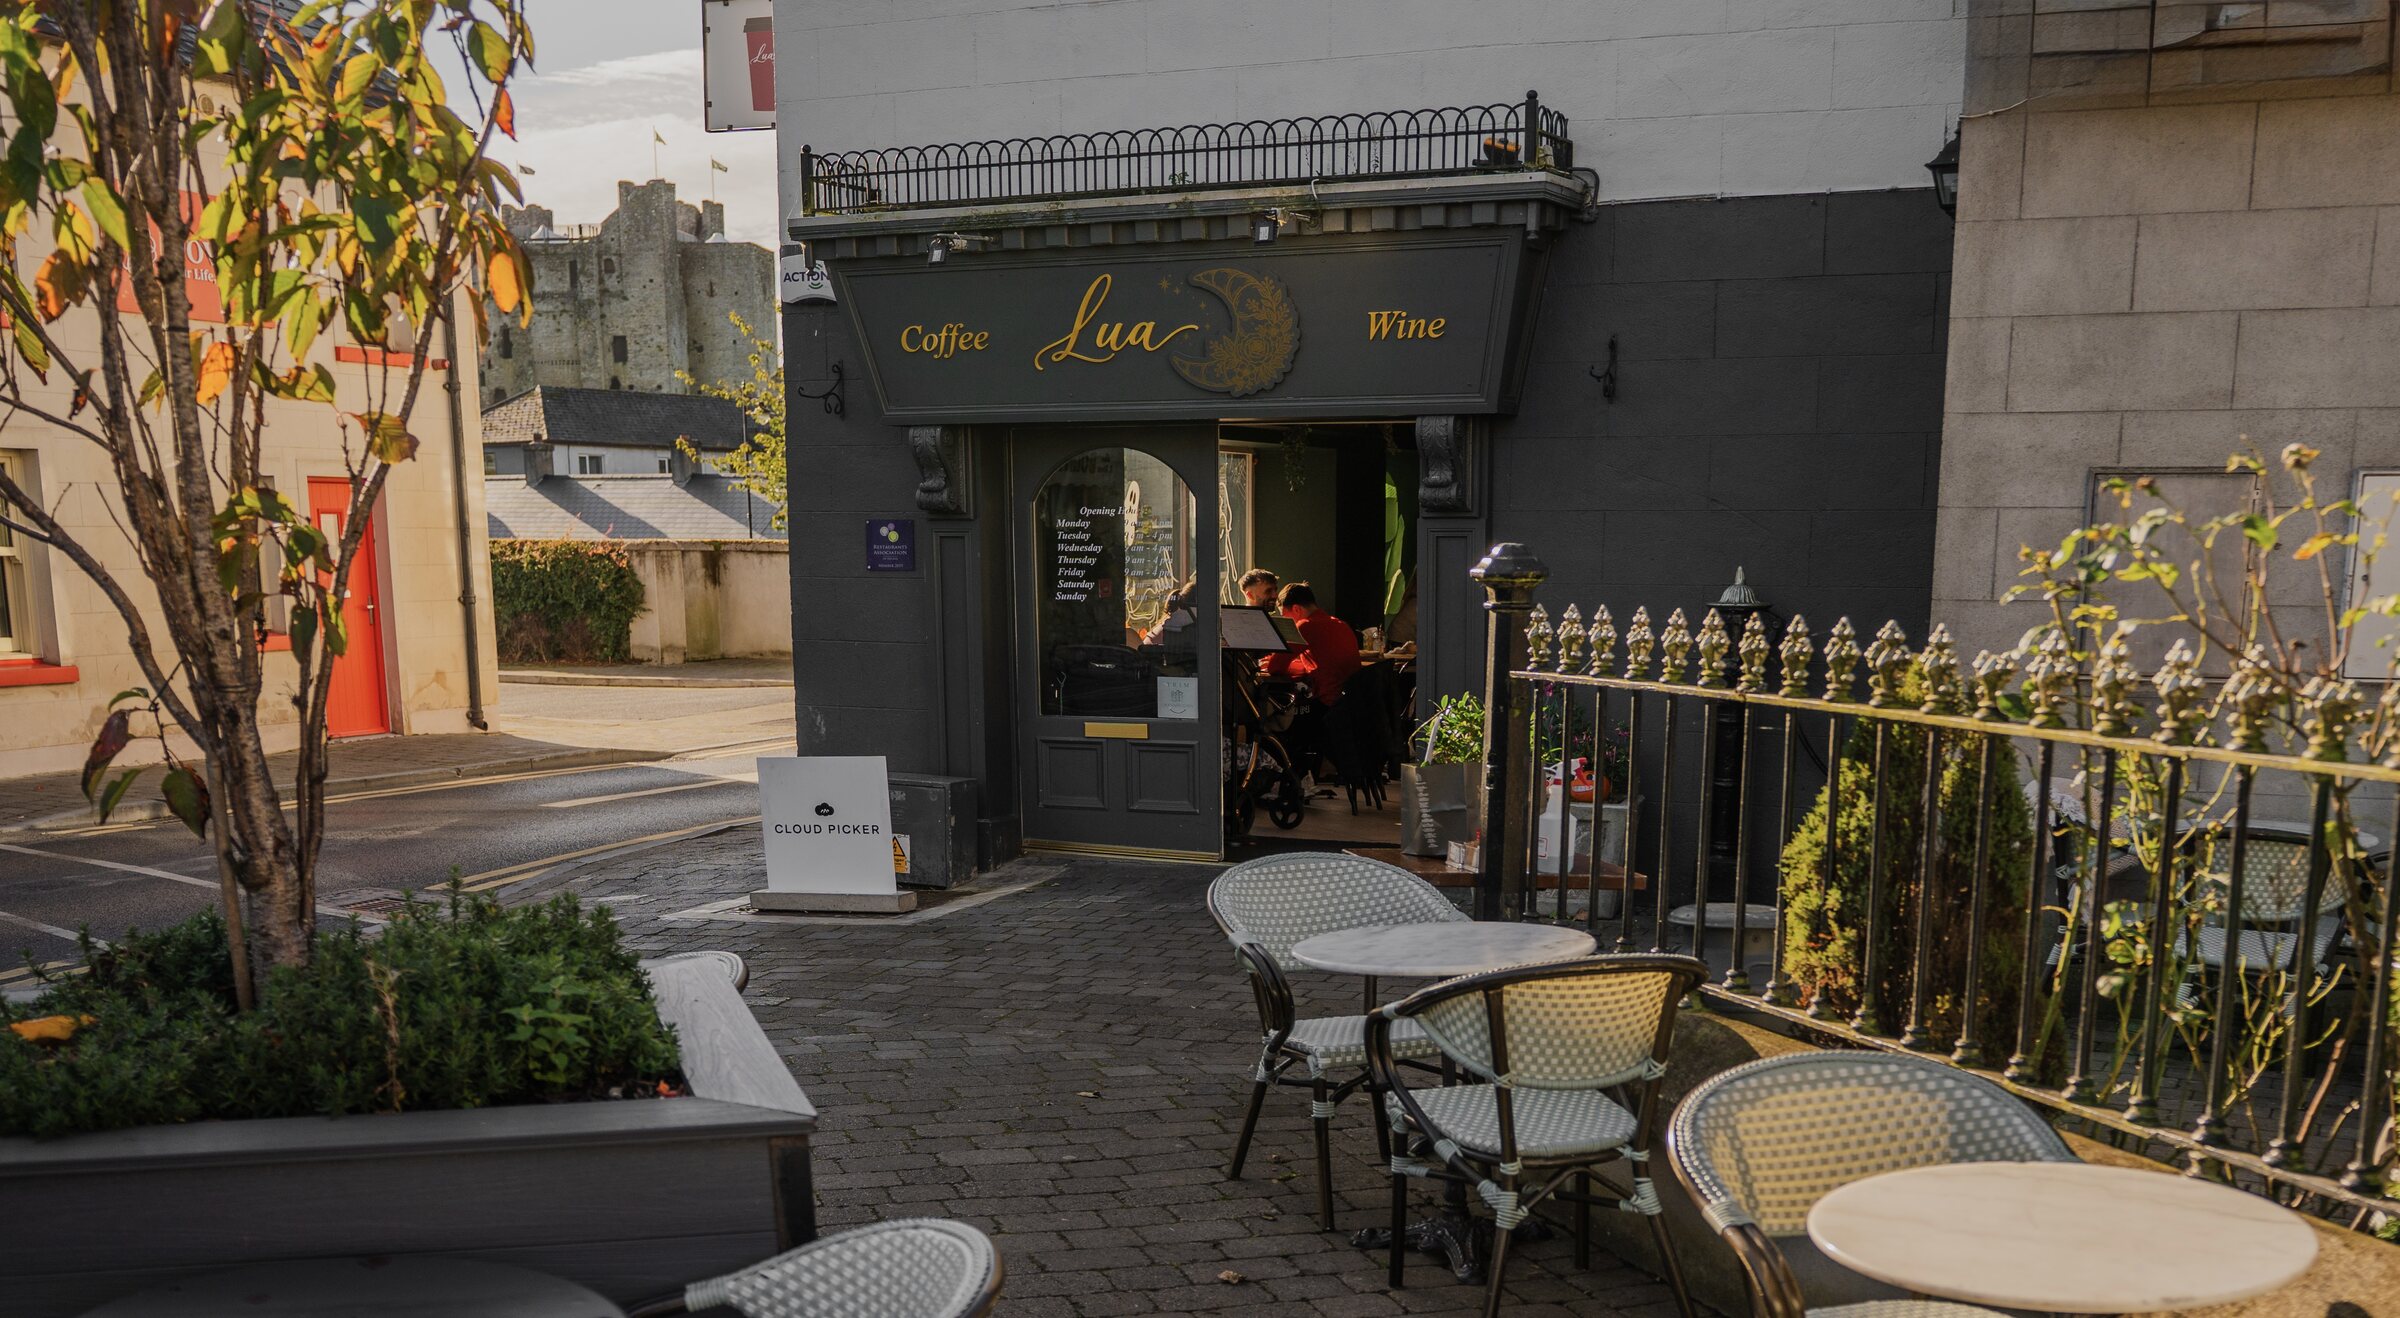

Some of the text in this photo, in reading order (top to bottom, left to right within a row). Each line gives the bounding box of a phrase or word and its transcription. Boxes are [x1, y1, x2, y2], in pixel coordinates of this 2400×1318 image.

[783, 270, 830, 282] ACTION
[1034, 273, 1199, 371] Lua
[1368, 310, 1446, 340] Wine
[901, 323, 989, 359] Coffee
[1080, 506, 1115, 517] Opening
[1056, 519, 1091, 529] Monday
[1057, 531, 1091, 541] Tuesday
[1152, 531, 1158, 539] 4
[1158, 532, 1172, 541] pm
[1057, 543, 1103, 553] Wednesday
[1158, 545, 1173, 554] pm
[1058, 555, 1097, 565] Thursday
[1125, 556, 1131, 564] 9
[1153, 556, 1159, 564] 4
[1058, 567, 1086, 577] Friday
[1124, 568, 1130, 576] 9
[1152, 567, 1158, 576] 4
[1057, 580, 1095, 590] Saturday
[1055, 592, 1087, 602] Sunday
[774, 824, 880, 835] CLOUD PICKER
